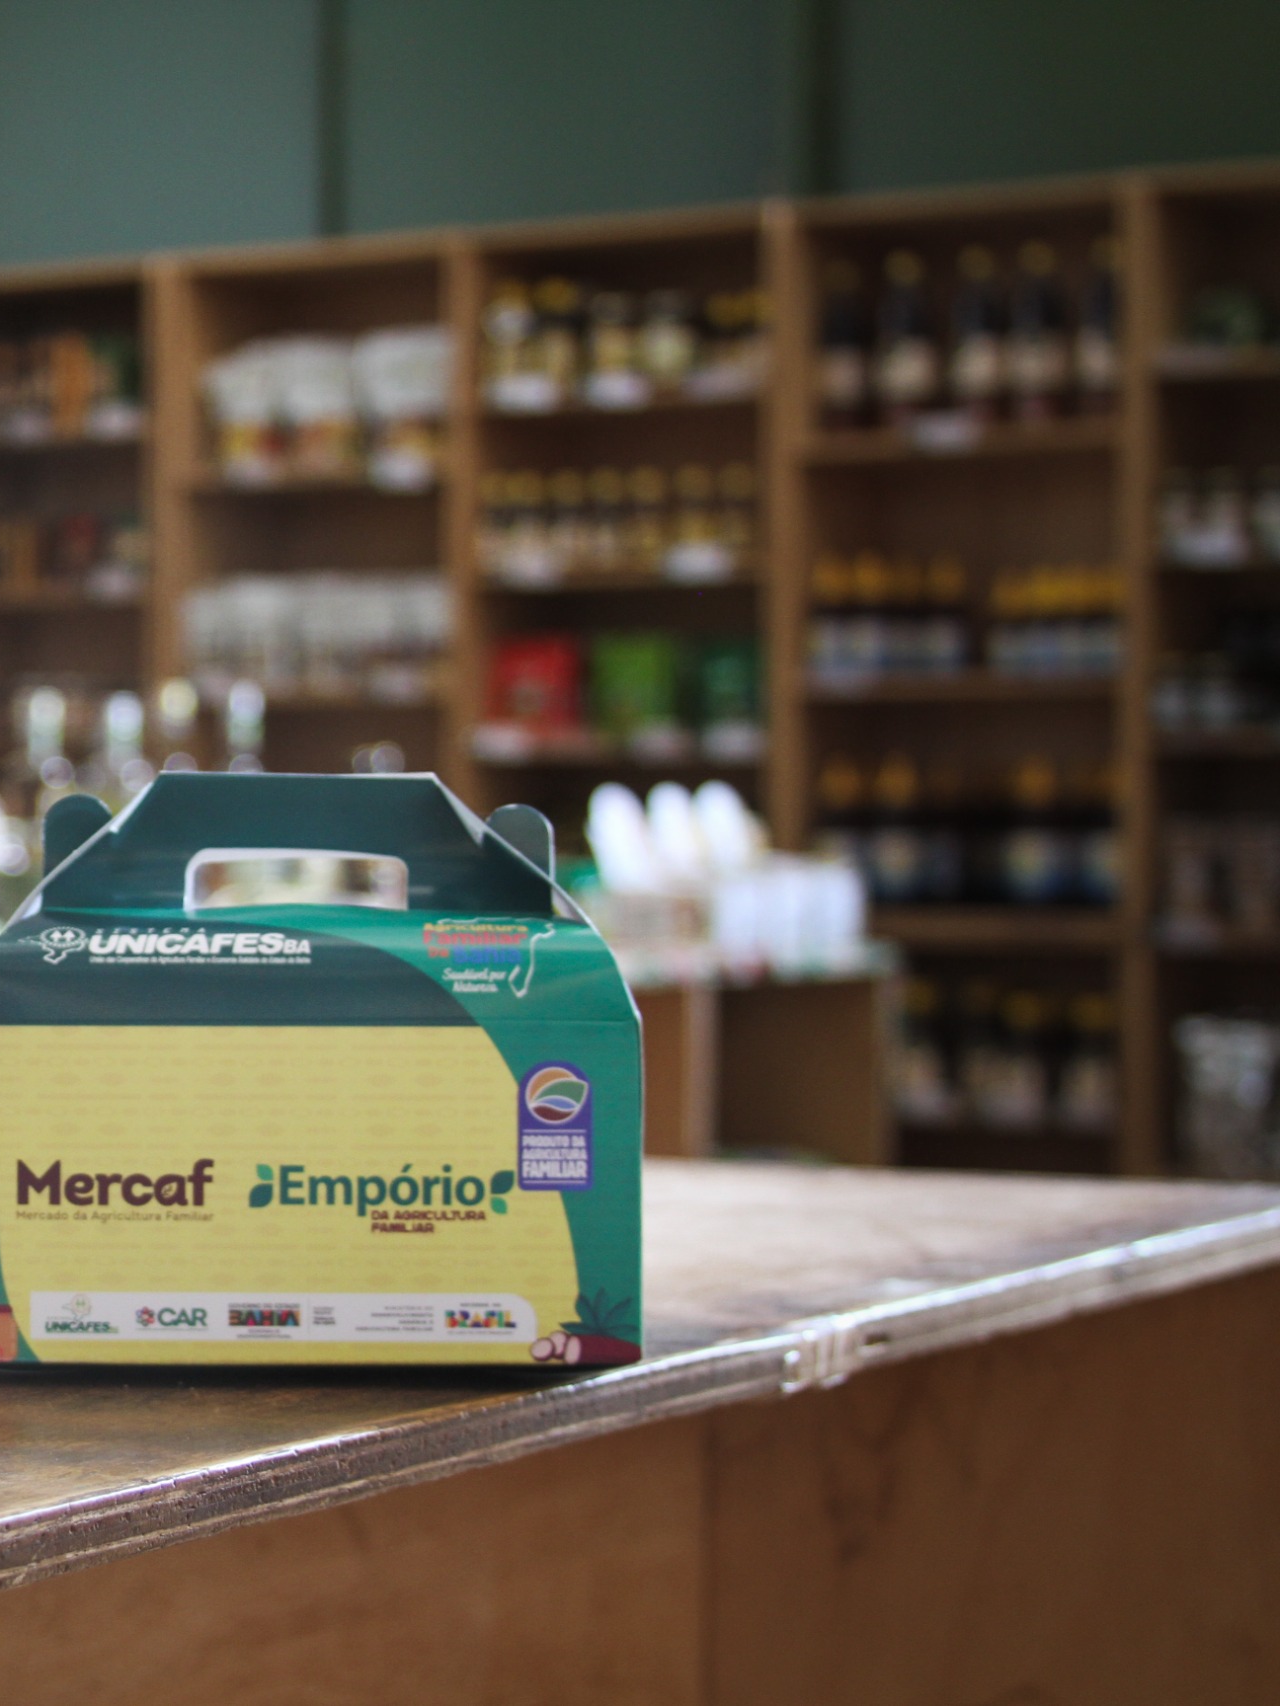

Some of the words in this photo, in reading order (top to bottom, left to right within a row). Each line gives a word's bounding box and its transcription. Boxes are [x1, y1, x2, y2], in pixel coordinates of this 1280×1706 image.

[423, 929, 527, 945] Familiar
[522, 1160, 587, 1178] FAMILIAR
[17, 1158, 214, 1207] Mercaf
[279, 1164, 486, 1217] Empório
[16, 1210, 68, 1221] Mercado
[73, 1210, 88, 1221] da
[91, 1210, 162, 1224] Agricultura
[166, 1210, 214, 1221] Familiar
[371, 1210, 390, 1221] DA
[393, 1210, 486, 1221] AGRICULTURA
[371, 1222, 435, 1233] FAMILIAR
[157, 1307, 208, 1327] CAR
[228, 1309, 302, 1327] BAHIA
[445, 1310, 517, 1328] BRASIL
